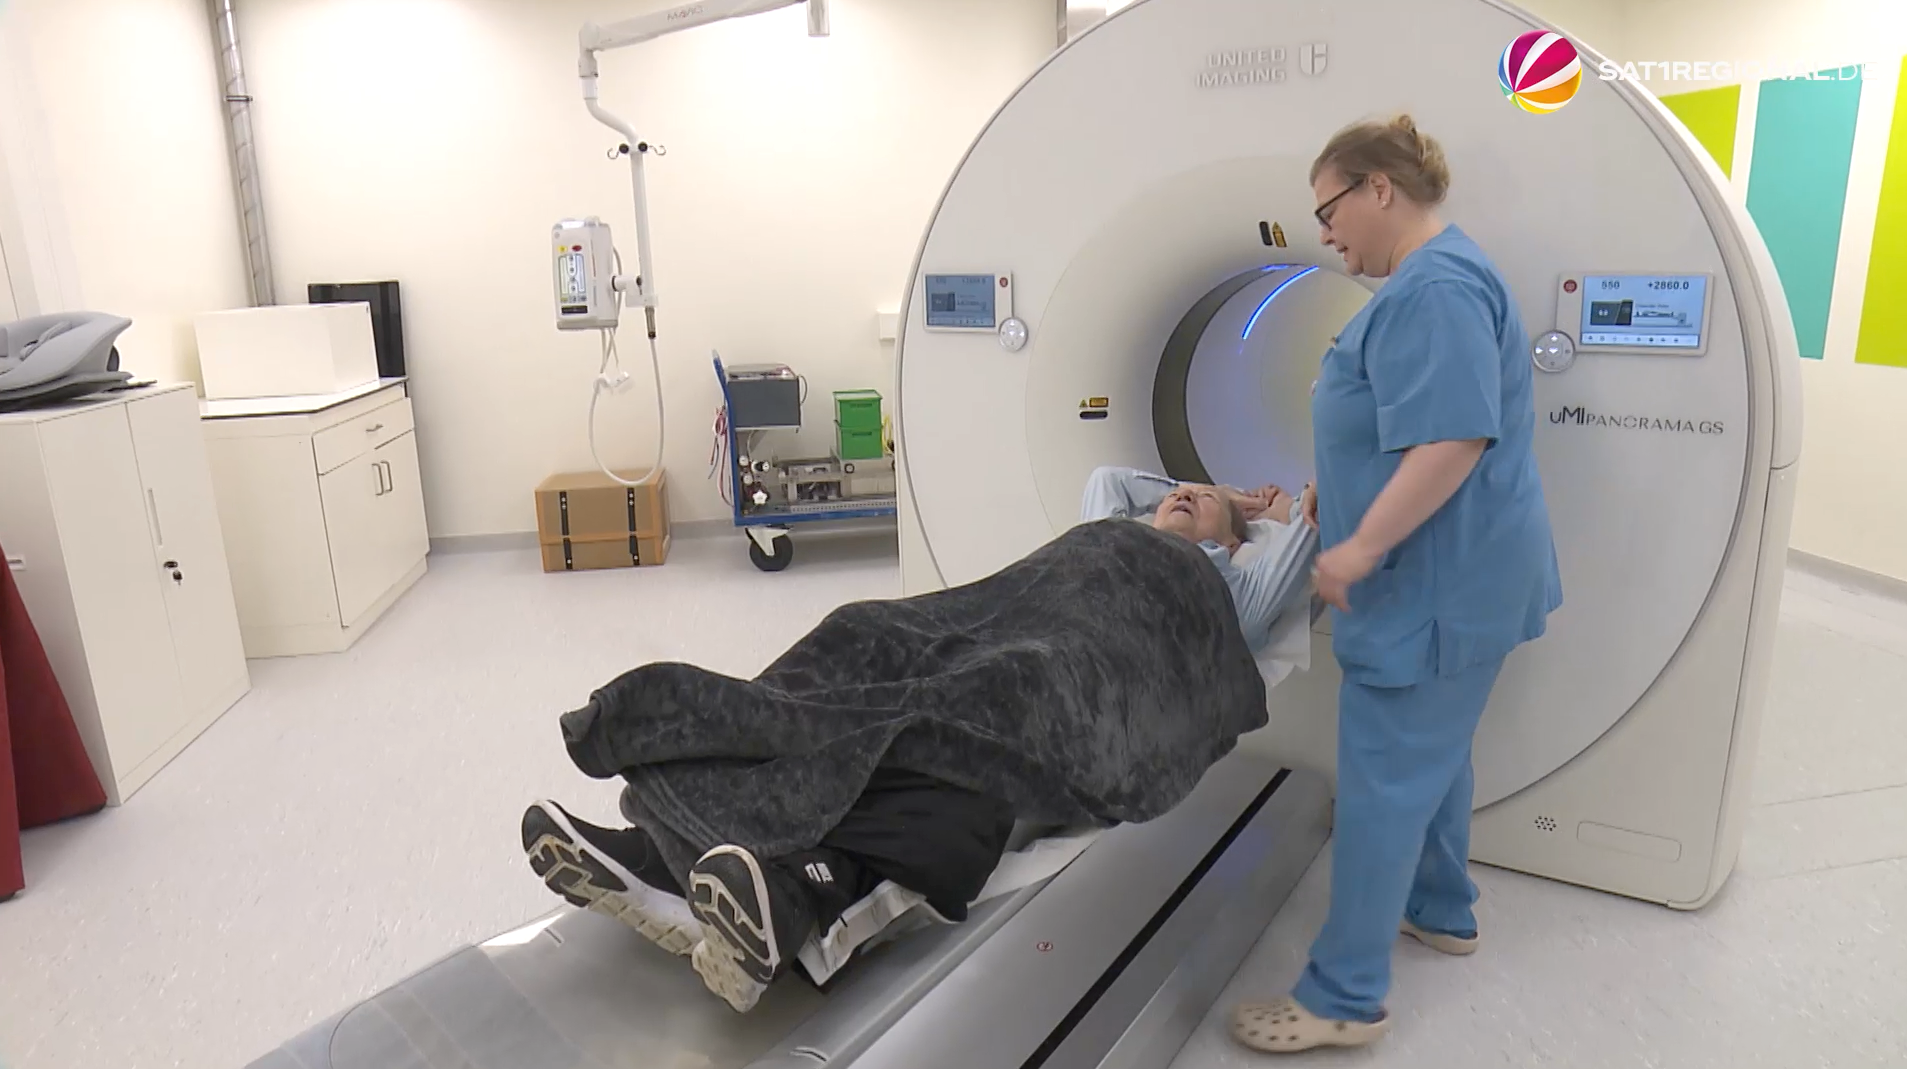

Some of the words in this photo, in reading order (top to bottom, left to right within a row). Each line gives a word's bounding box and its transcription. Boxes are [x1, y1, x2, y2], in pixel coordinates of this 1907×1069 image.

[1208, 48, 1286, 67] UNITED
[1196, 68, 1286, 87] IMAGING
[1601, 280, 1620, 290] 550
[1699, 421, 1725, 435] GS
